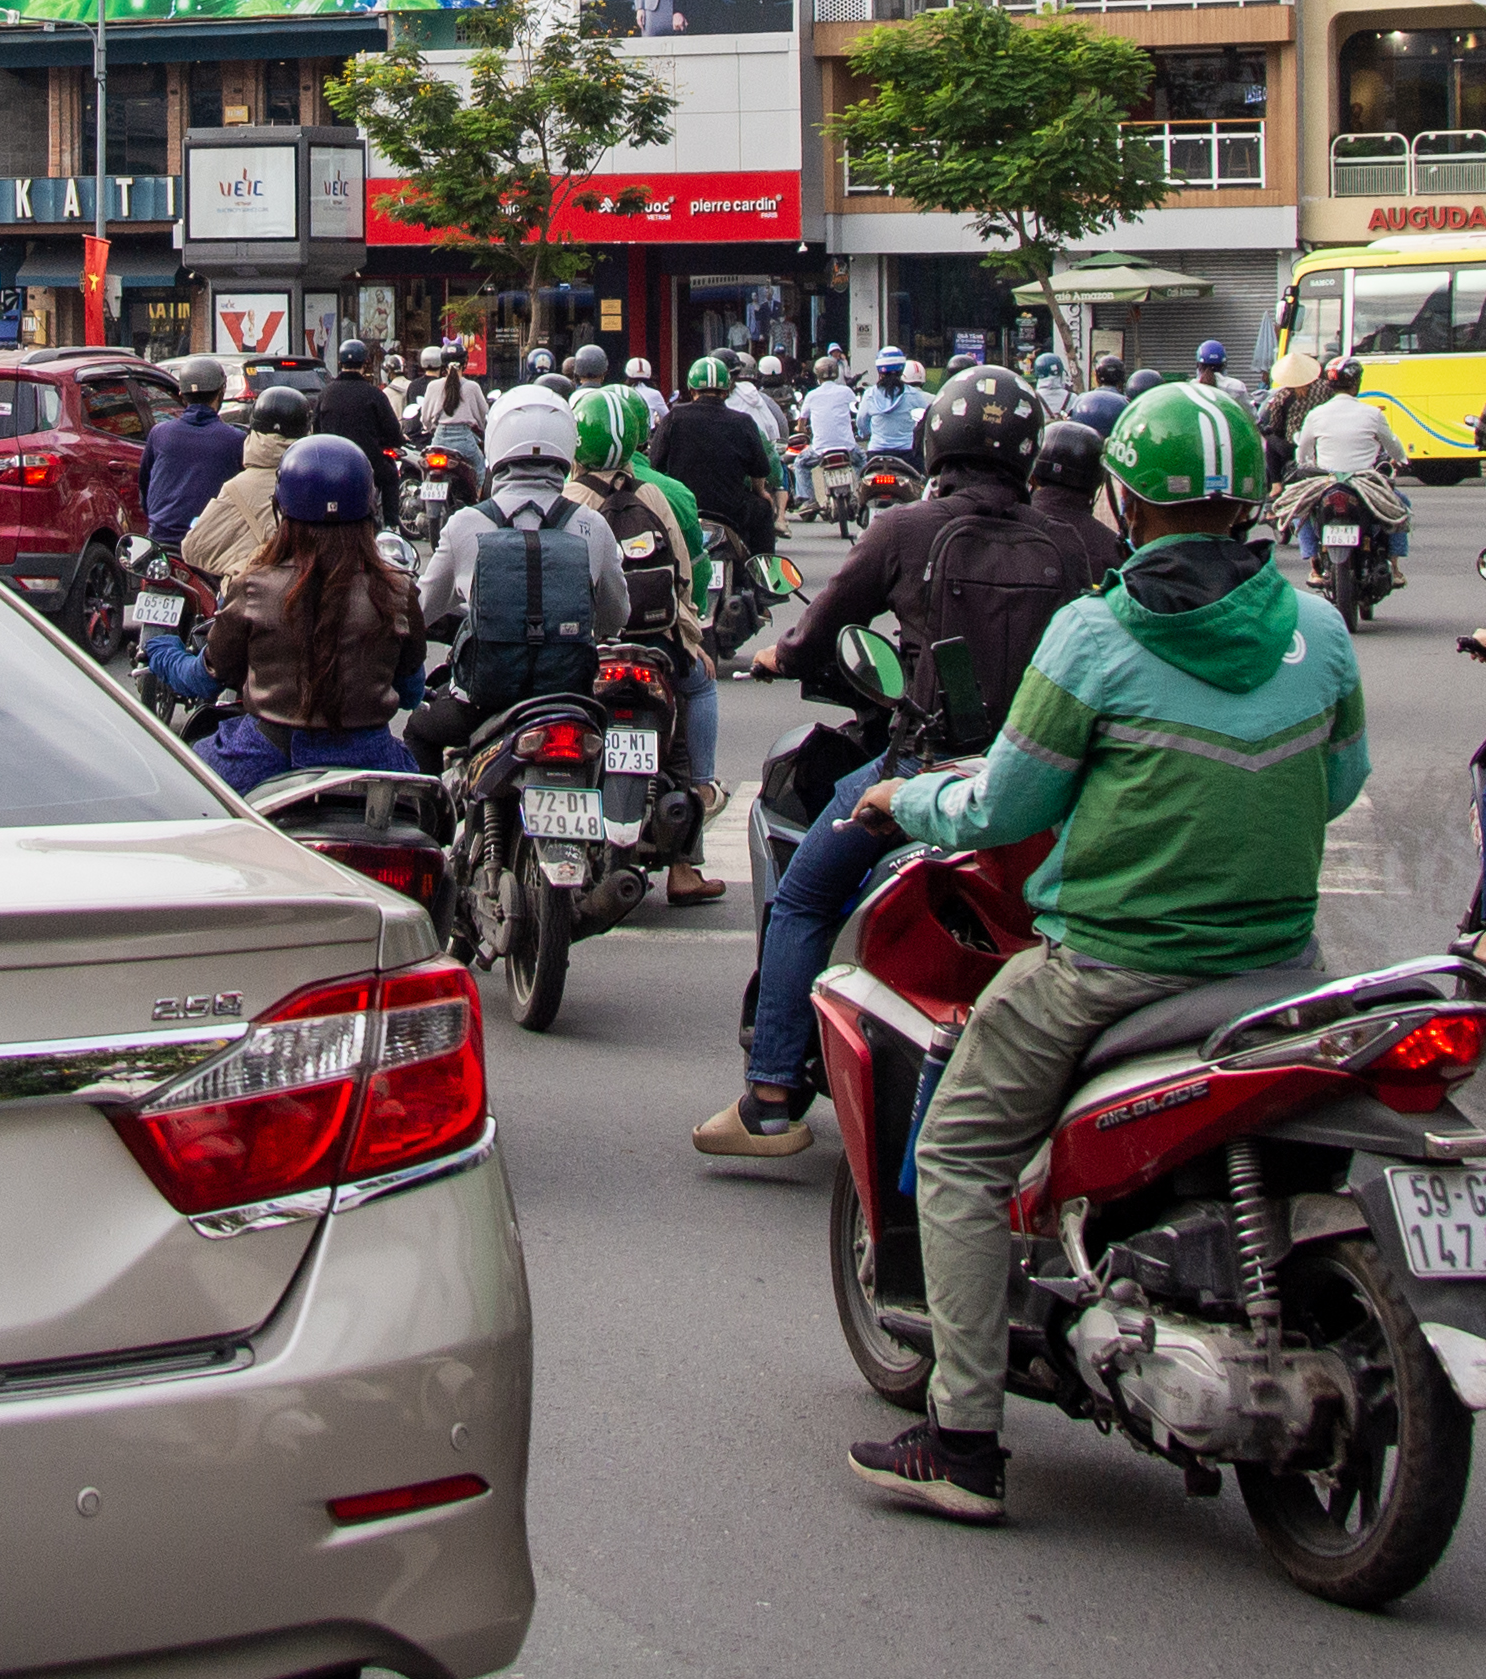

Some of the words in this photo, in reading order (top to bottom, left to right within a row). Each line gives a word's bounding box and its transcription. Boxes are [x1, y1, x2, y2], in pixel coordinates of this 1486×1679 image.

[690, 198, 731, 216] pierre
[733, 197, 777, 212] cardin
[1054, 291, 1071, 302] afé
[1073, 291, 1115, 302] Amazon
[143, 595, 176, 611] 65-G1
[136, 607, 178, 624] 014.20
[608, 751, 654, 770] 67.35
[534, 790, 588, 814] 72-D1
[528, 813, 598, 836] 529.48
[1095, 1104, 1132, 1132] AIR
[1132, 1080, 1211, 1119] BLADE
